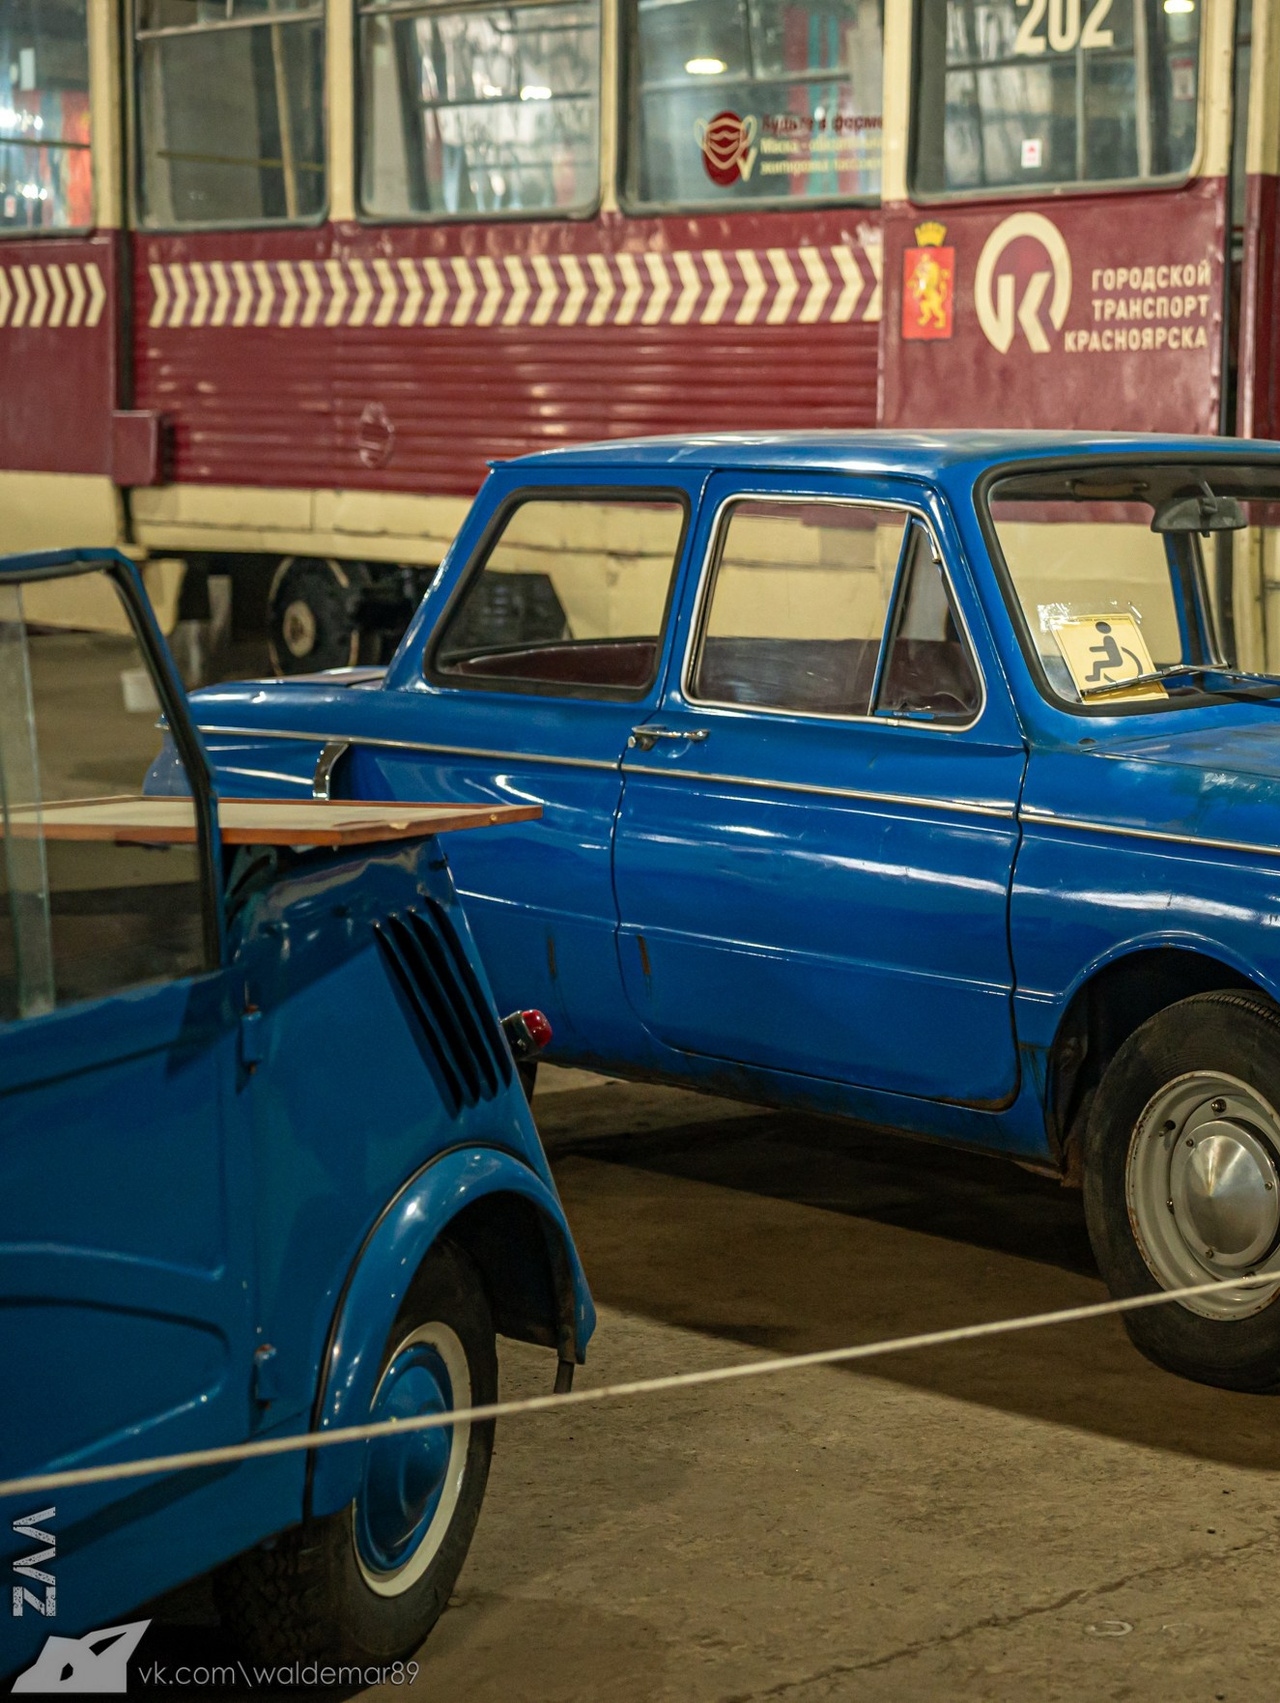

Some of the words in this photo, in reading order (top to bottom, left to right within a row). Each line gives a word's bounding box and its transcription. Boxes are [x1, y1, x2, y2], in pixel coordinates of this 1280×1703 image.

[1014, 0, 1114, 54] 202
[1092, 259, 1211, 292] ГОРОДСКОЙ
[1092, 294, 1209, 322] ТРАНСПОРТ
[1064, 326, 1208, 353] КРАСНОЯРСКА
